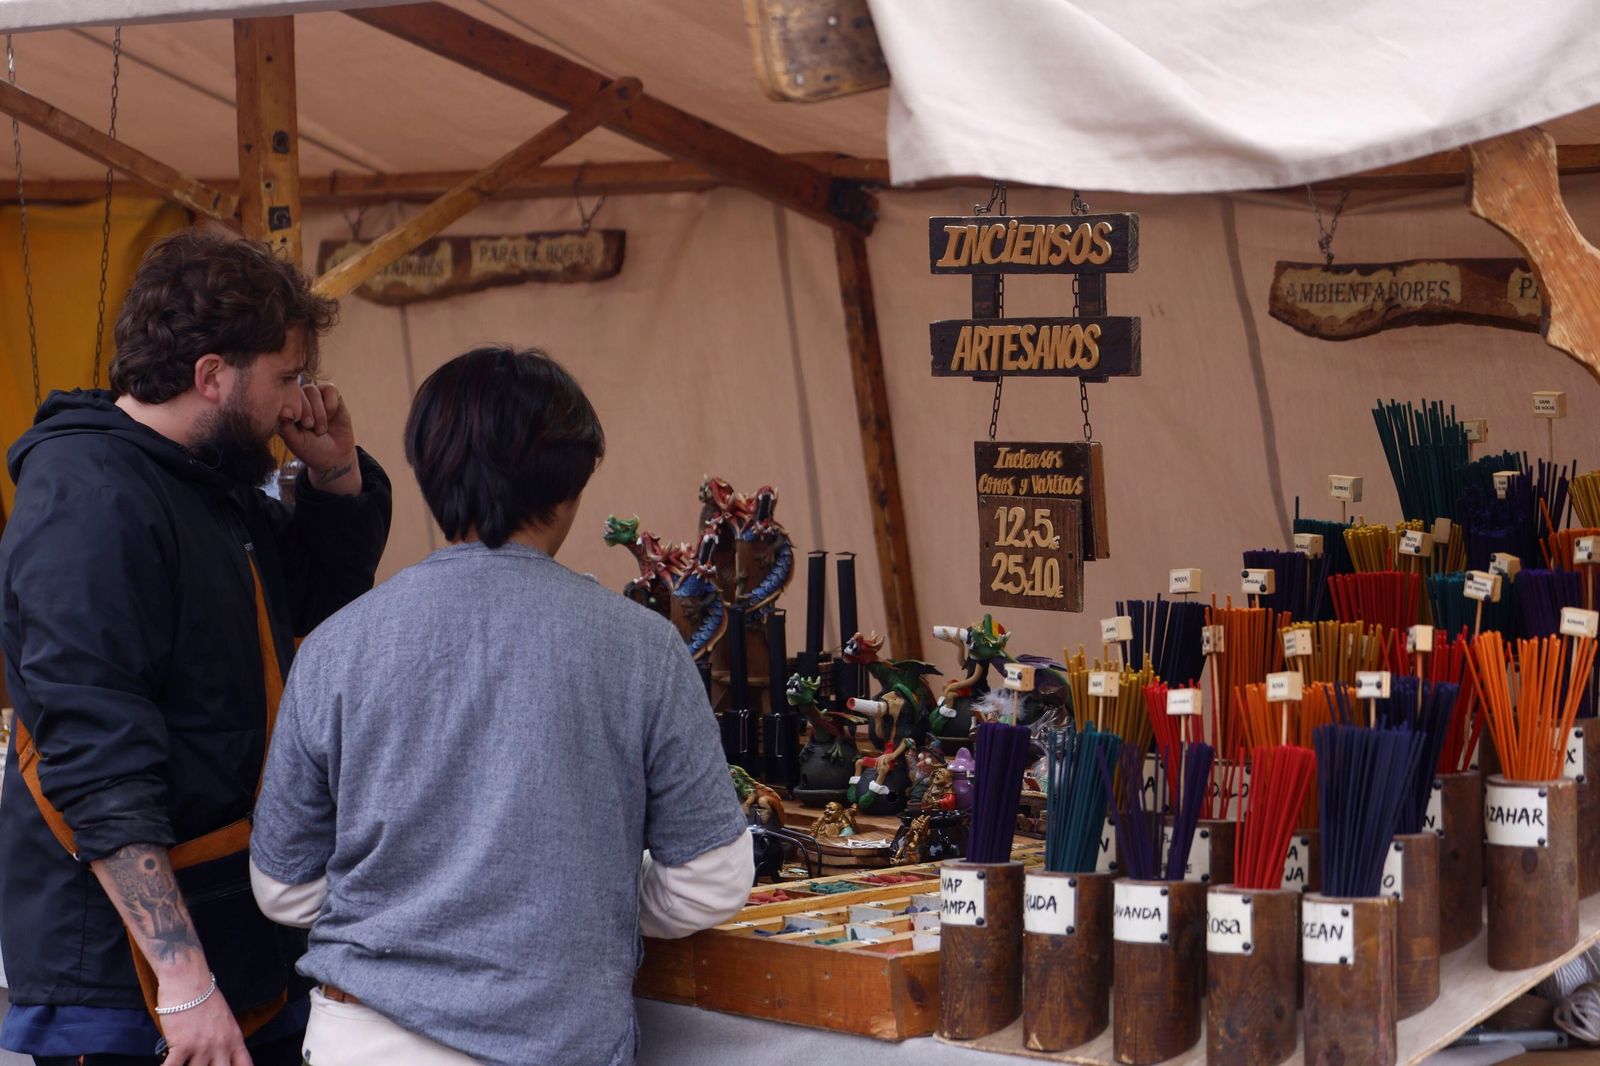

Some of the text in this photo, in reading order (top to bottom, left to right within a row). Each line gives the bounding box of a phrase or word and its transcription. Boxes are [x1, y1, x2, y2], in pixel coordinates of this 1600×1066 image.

[1285, 279, 1451, 305] AMBIENTADORES
[950, 323, 1102, 372] ARTESANOS
[993, 447, 1064, 470] Inciensos
[978, 473, 1085, 496] Conos y Varitas
[940, 898, 977, 917] AMPA
